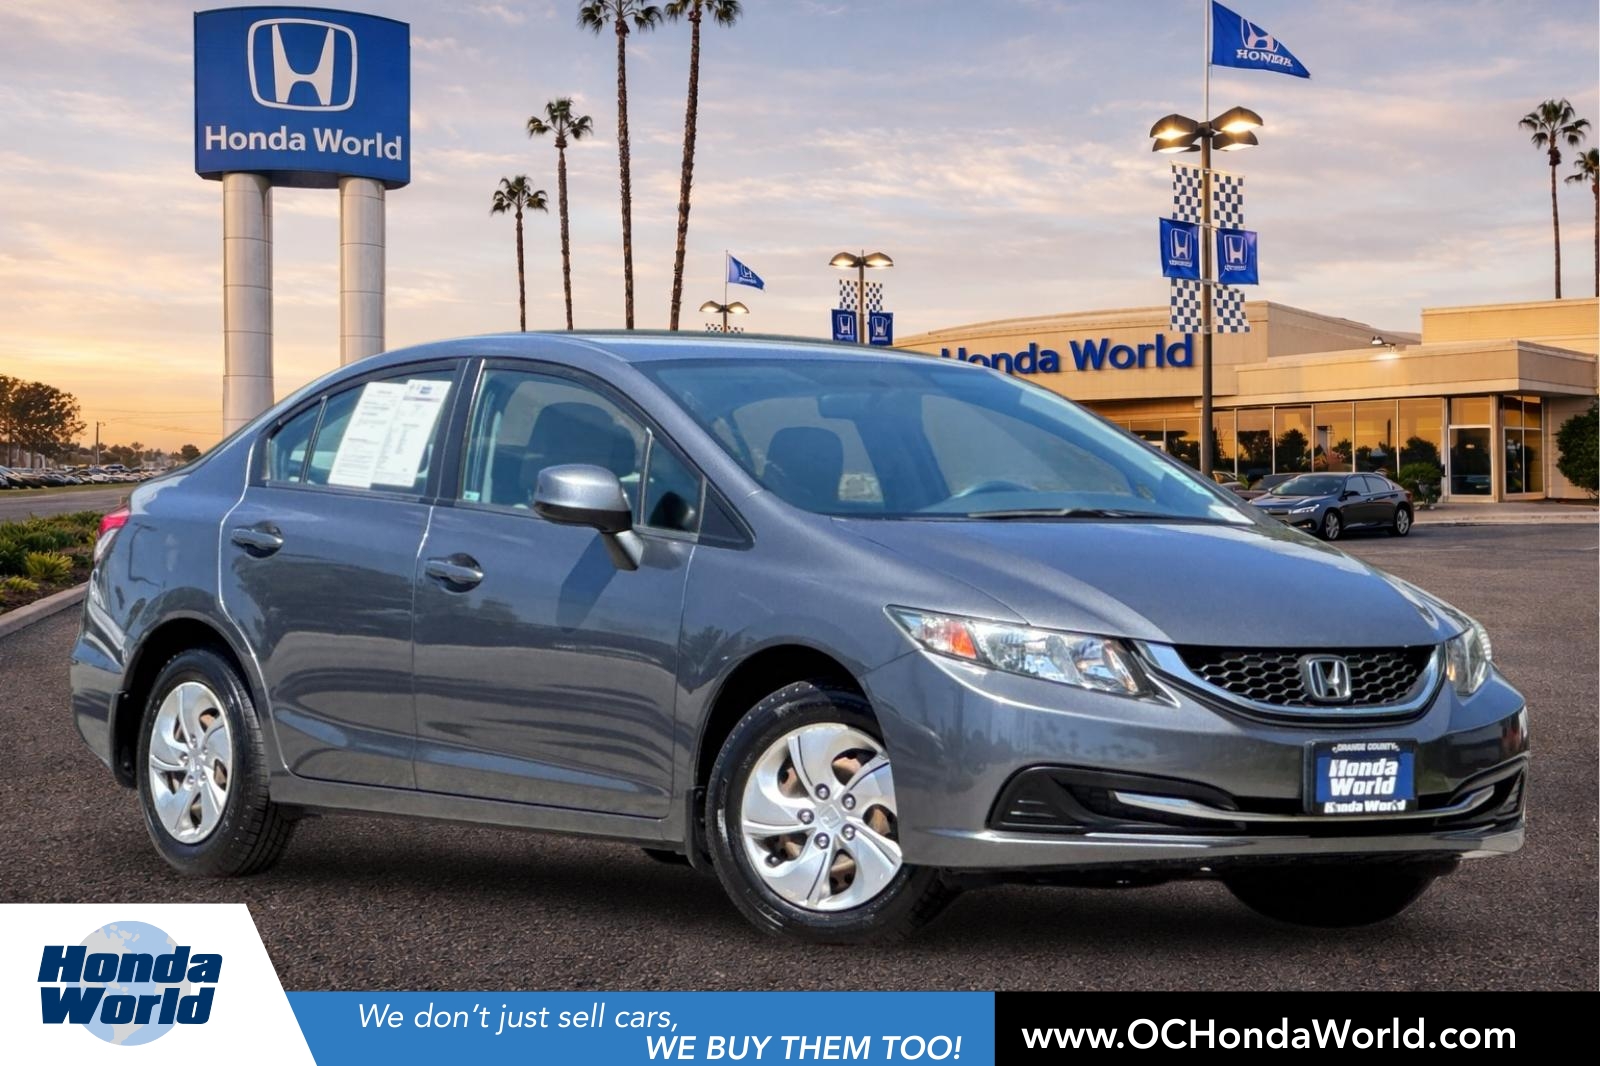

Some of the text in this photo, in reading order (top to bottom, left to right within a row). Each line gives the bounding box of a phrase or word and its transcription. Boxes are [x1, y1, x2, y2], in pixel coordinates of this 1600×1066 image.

[205, 125, 402, 161] Honda World
[1070, 333, 1194, 371] World
[1329, 758, 1399, 778] Honda
[1330, 777, 1397, 797] World
